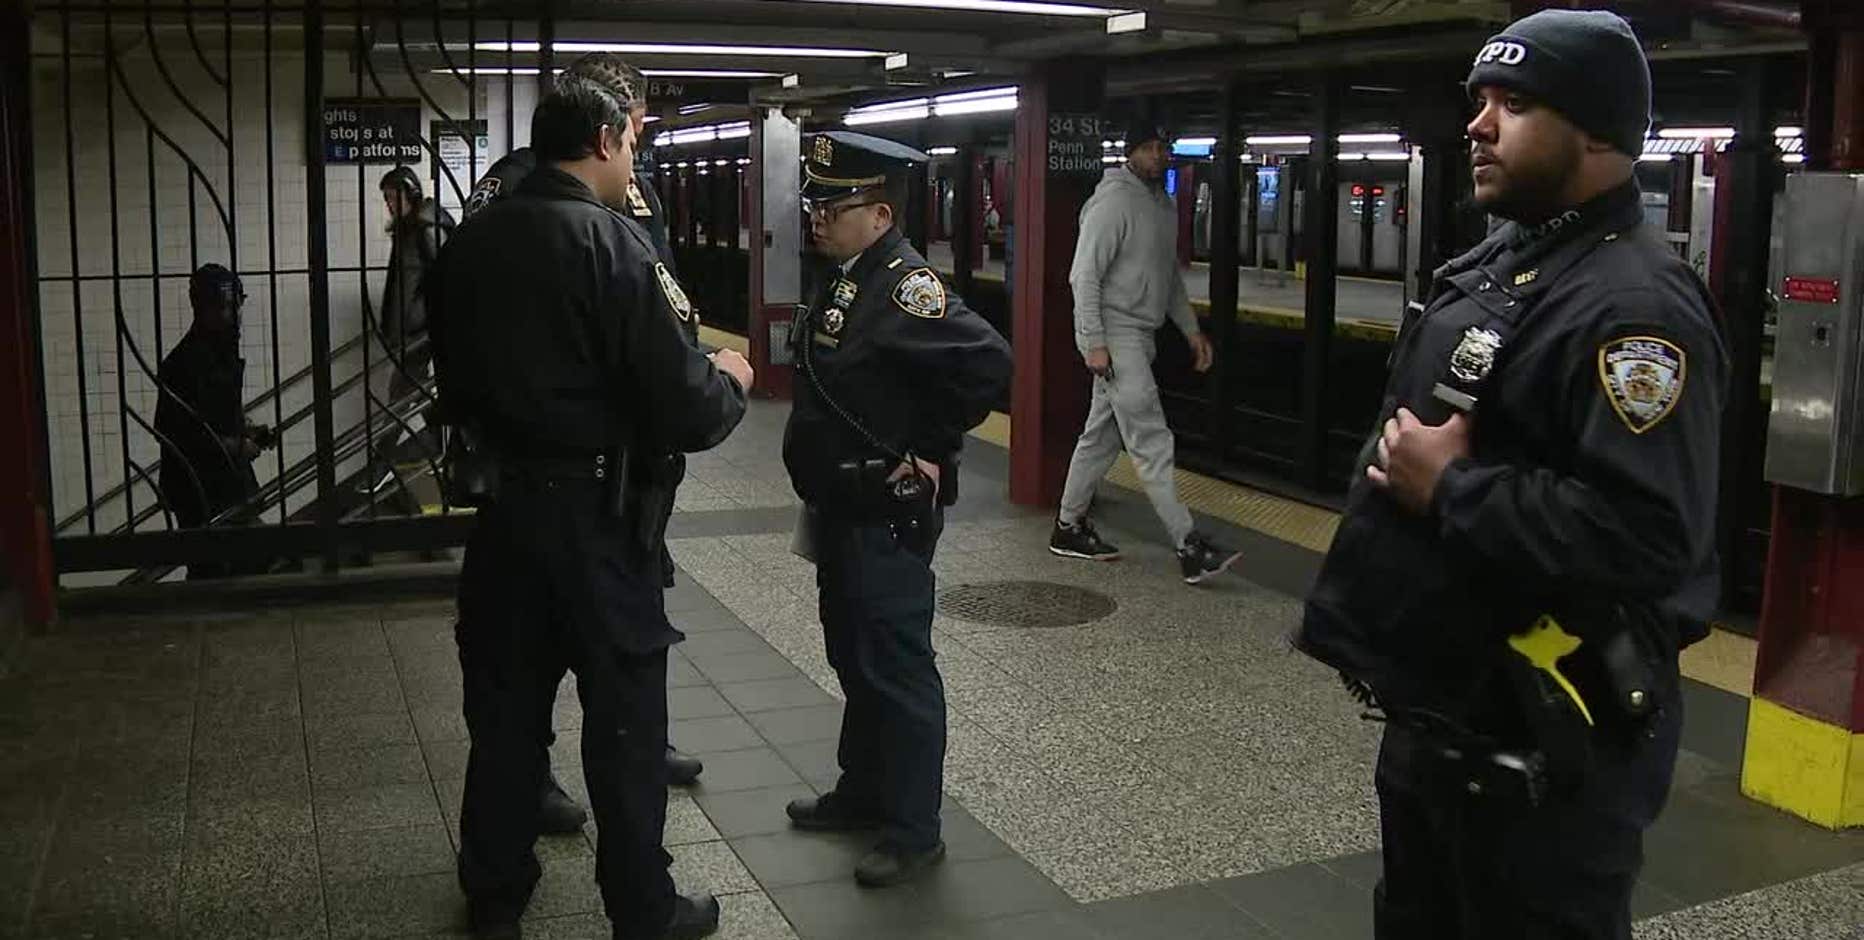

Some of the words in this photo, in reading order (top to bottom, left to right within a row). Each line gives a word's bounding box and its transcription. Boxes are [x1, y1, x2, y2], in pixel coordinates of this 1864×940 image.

[666, 84, 684, 96] Av
[324, 110, 357, 125] ghts
[378, 125, 394, 139] at
[1049, 118, 1073, 135] 34
[1080, 118, 1100, 136] St
[349, 143, 421, 160] patforms
[1048, 140, 1084, 154] Penn
[1048, 155, 1101, 170] Station
